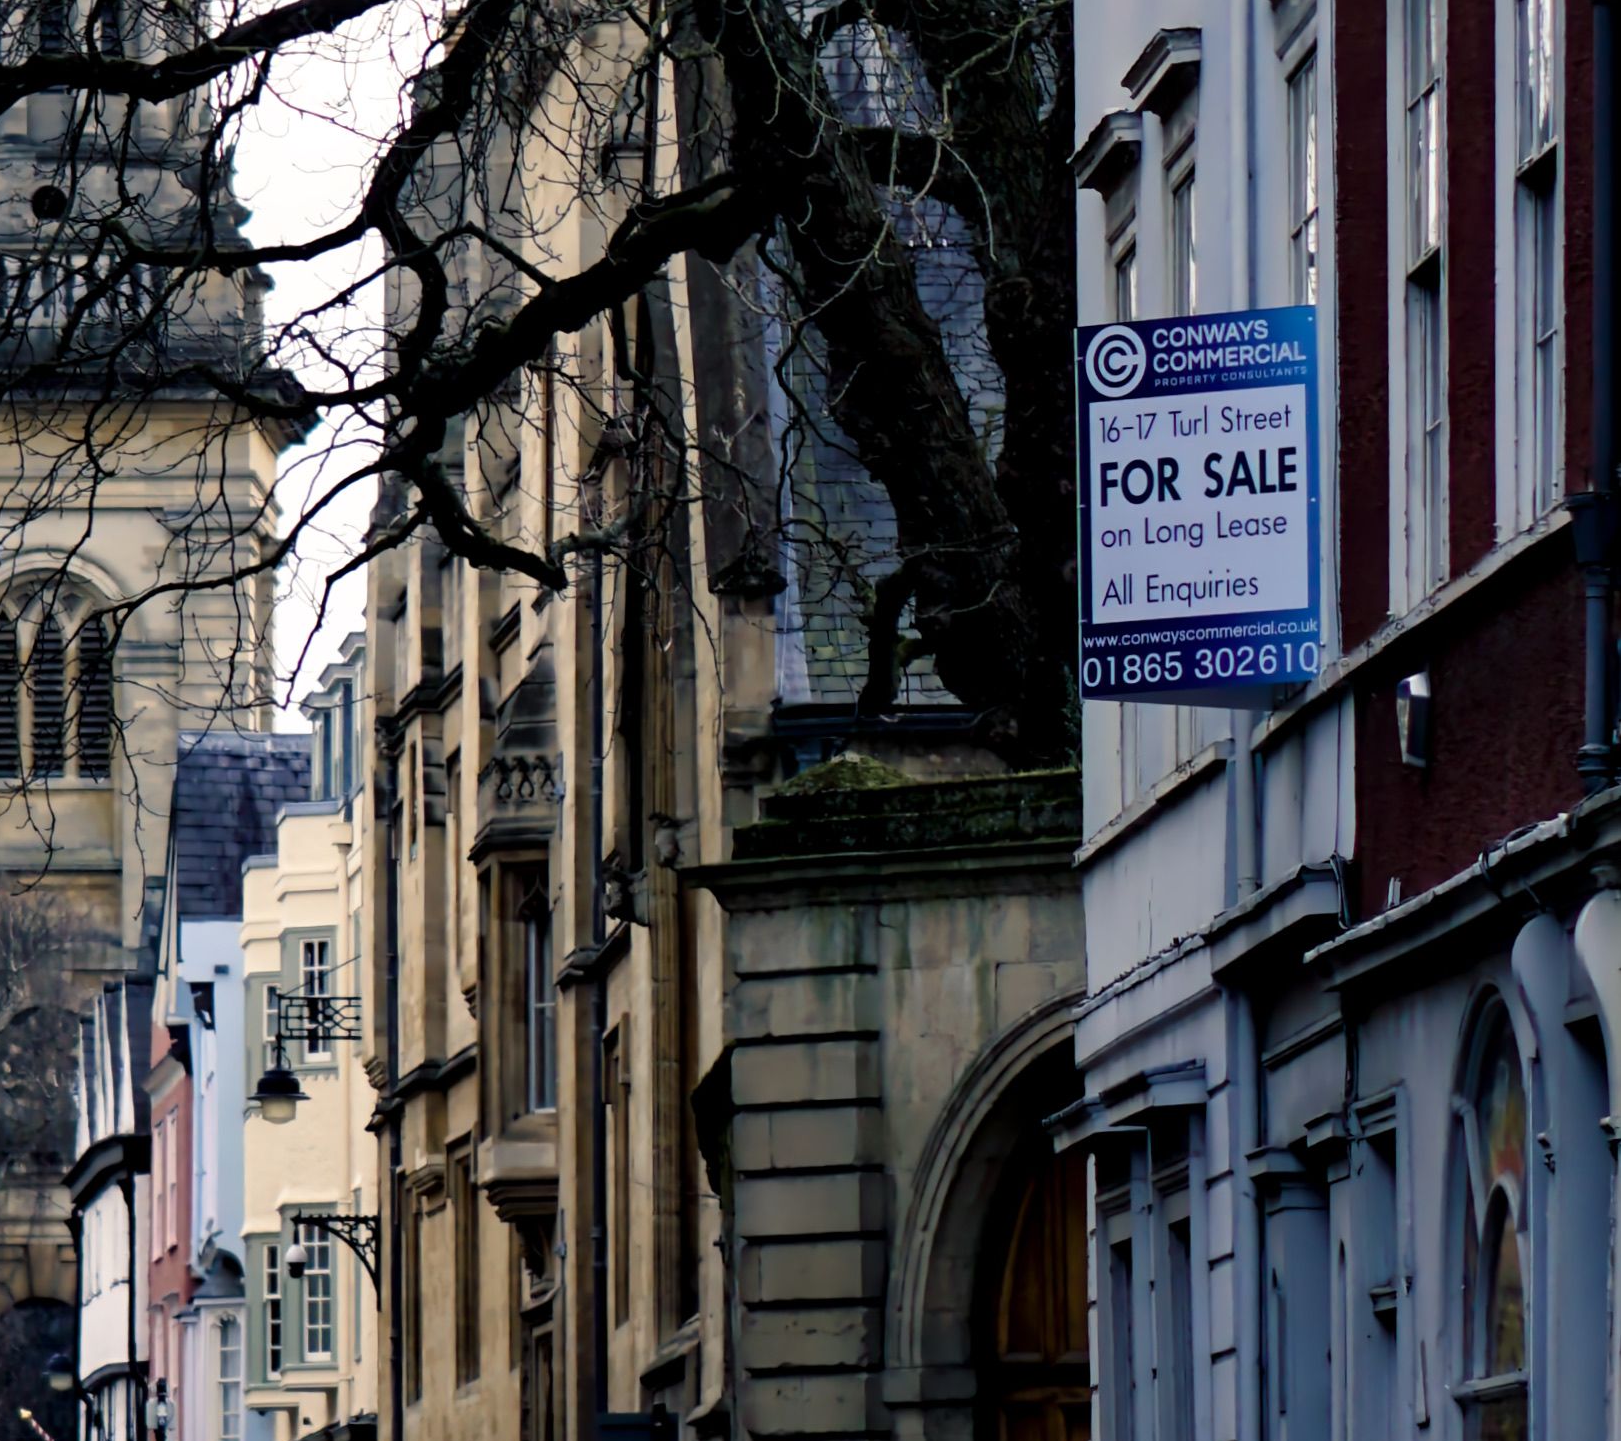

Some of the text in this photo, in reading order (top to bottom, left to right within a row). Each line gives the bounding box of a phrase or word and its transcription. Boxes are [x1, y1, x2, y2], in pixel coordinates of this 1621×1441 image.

[1151, 319, 1269, 349] CONWAYS
[1152, 341, 1307, 374] COMMERCIAL
[1154, 365, 1308, 387] PROPERTY CONSULTANTS
[1099, 404, 1292, 444] 16-17 Turl Street
[1099, 446, 1298, 507] FOR SALE
[1100, 510, 1288, 549] on Long Lease
[1101, 568, 1259, 608] All Enquiries
[1082, 617, 1318, 648] www.conwayscommercial.co.uk
[1082, 641, 1319, 688] 01865 302610
